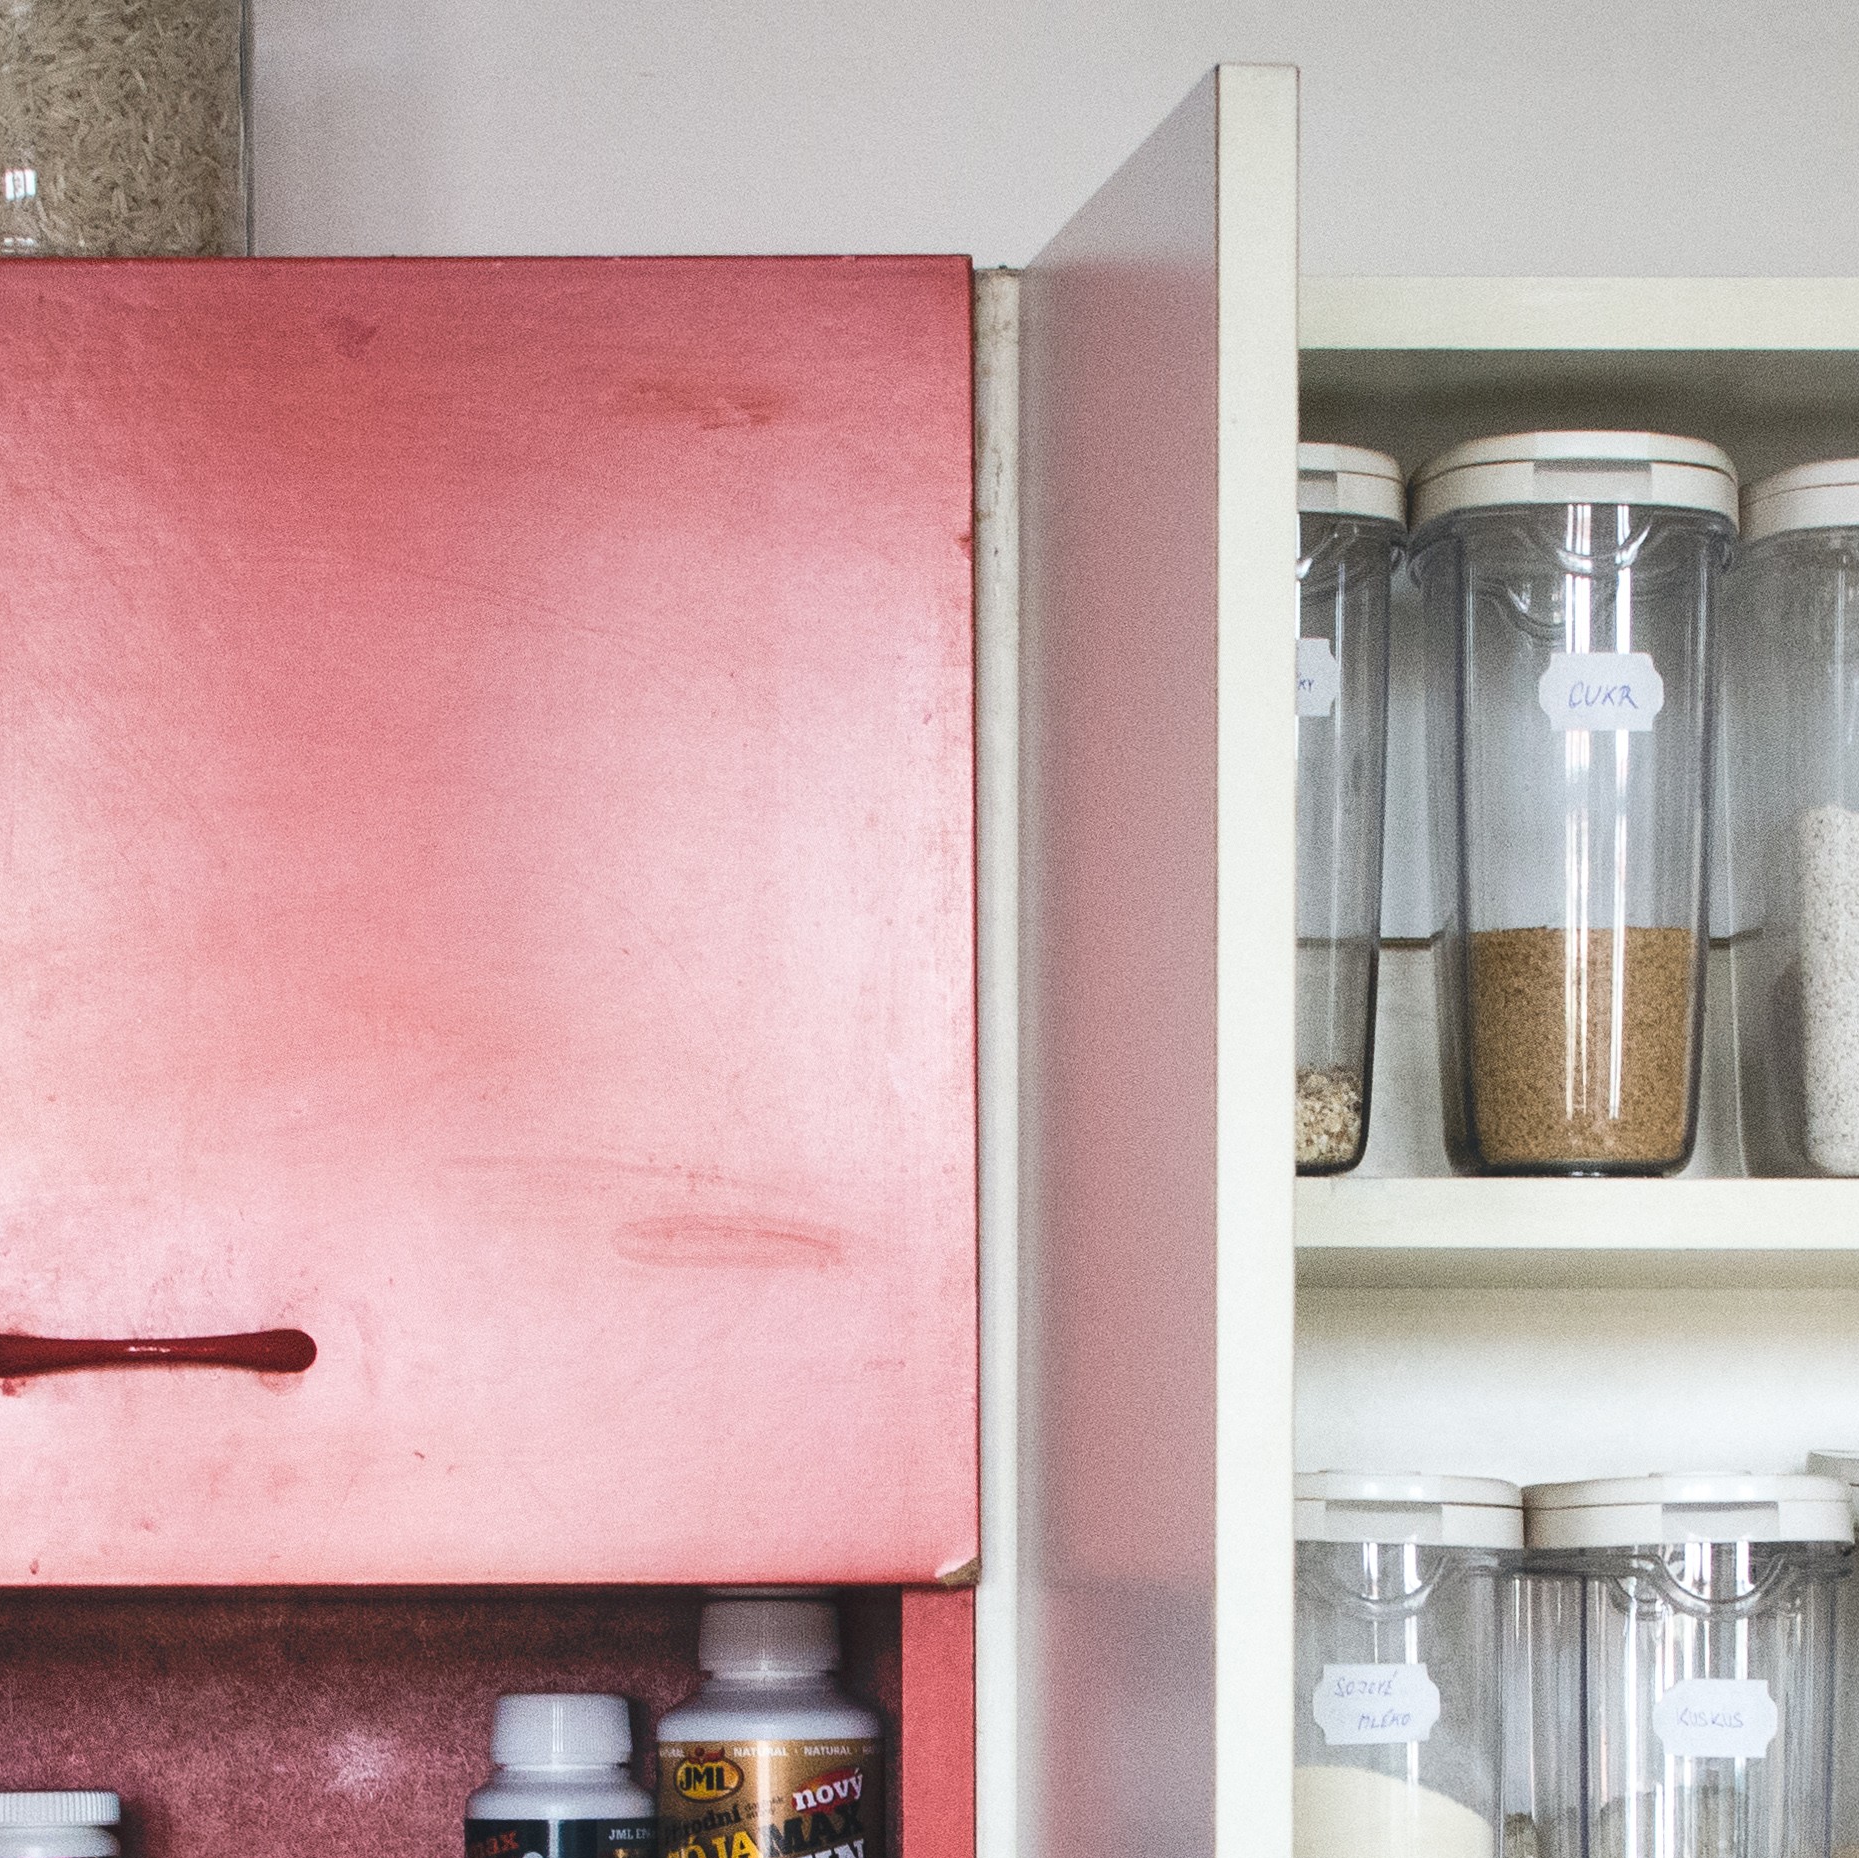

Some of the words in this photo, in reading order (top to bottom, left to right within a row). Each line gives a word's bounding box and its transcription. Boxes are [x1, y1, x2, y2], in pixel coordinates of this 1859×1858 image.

[1568, 681, 1640, 710] CUKR
[1676, 1706, 1744, 1729] KUSKUS
[679, 1765, 732, 1792] JML
[792, 1766, 863, 1811] nový
